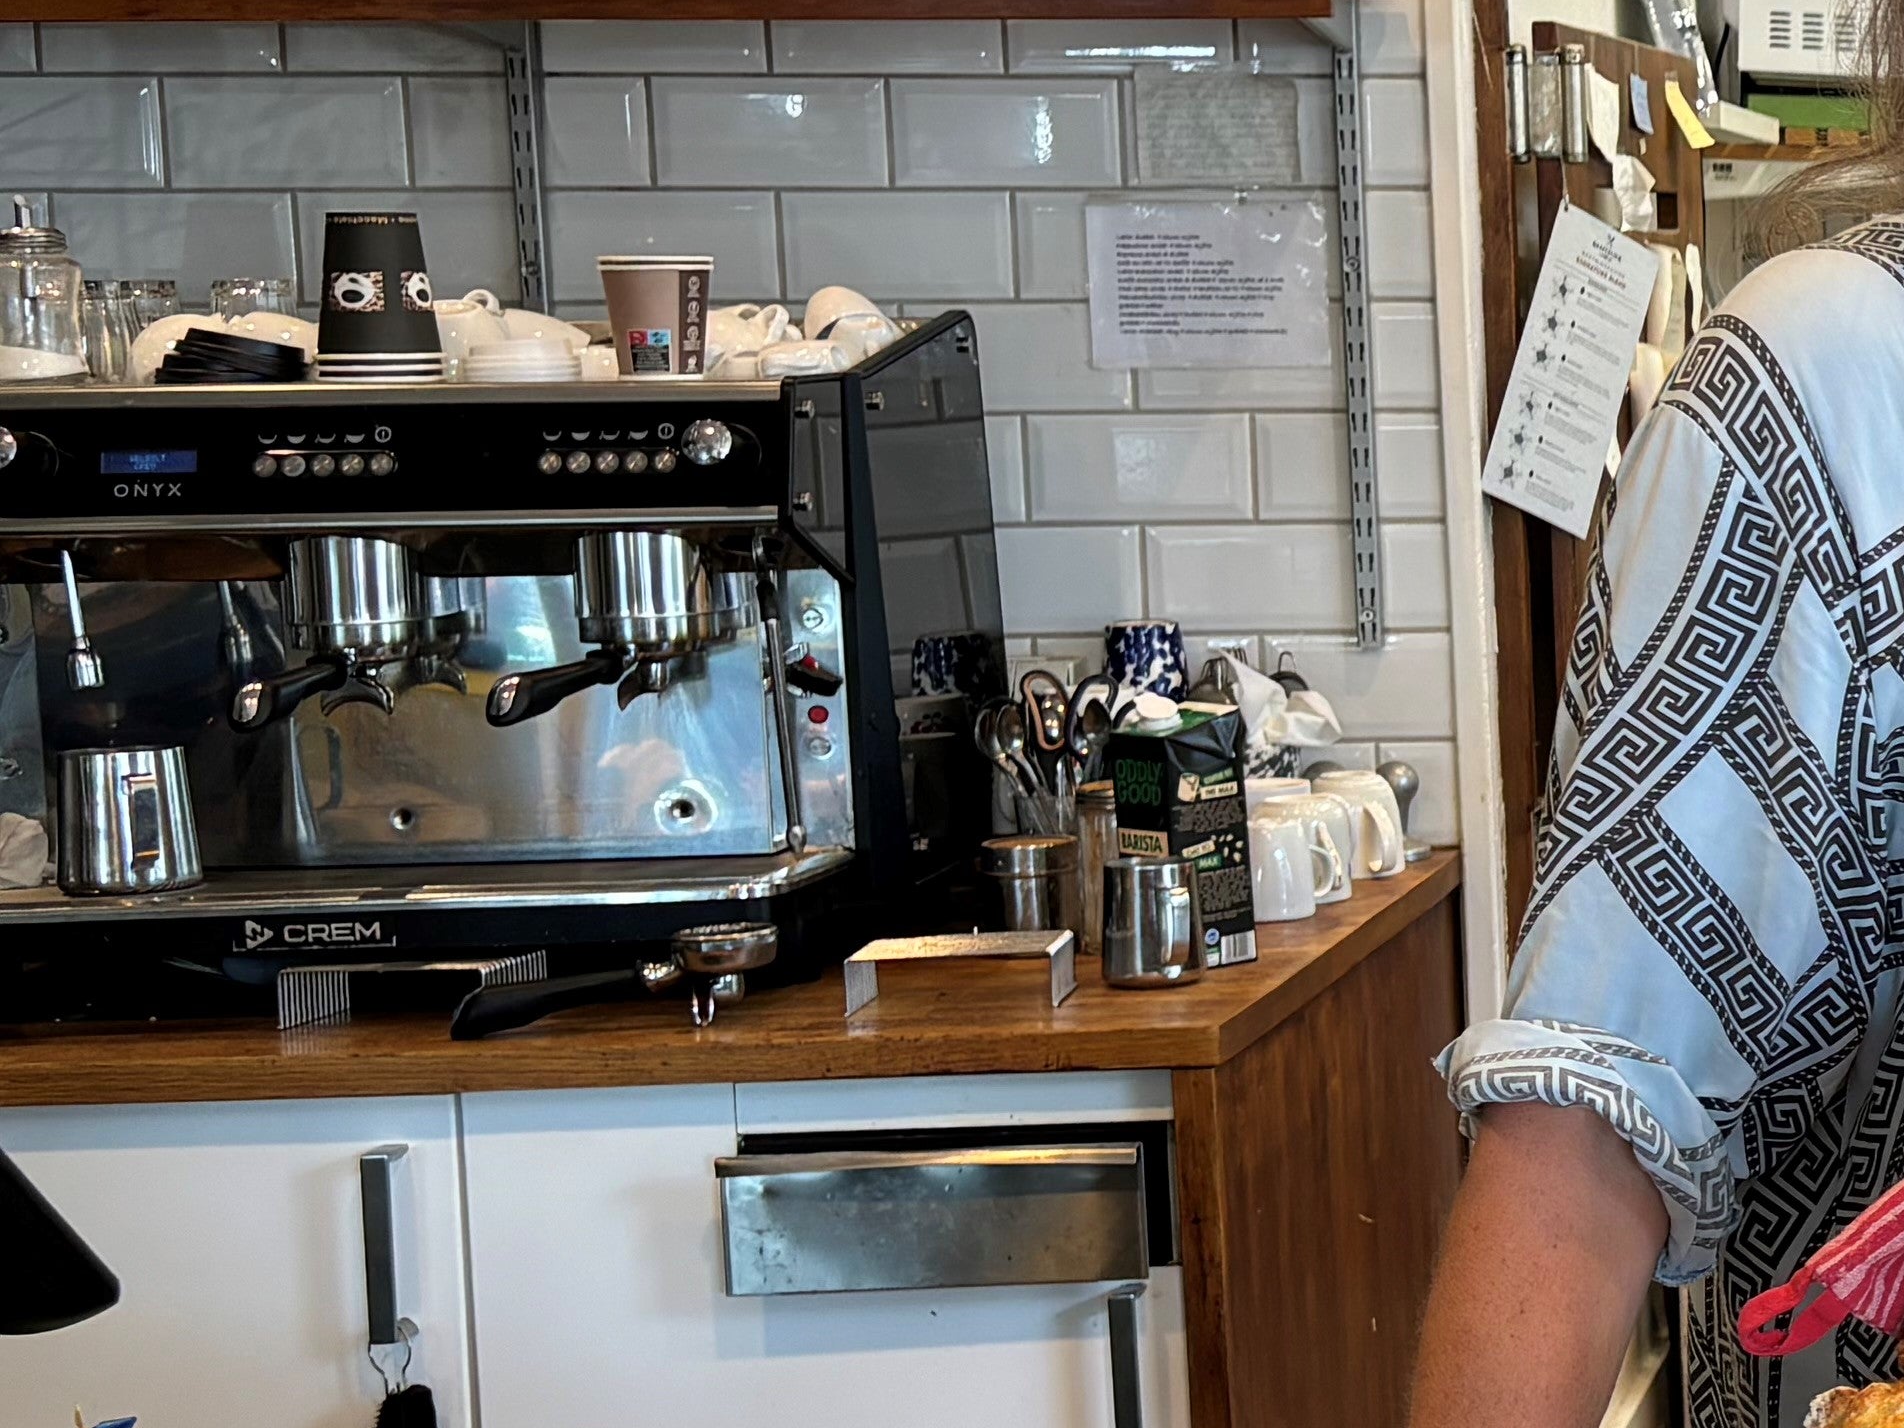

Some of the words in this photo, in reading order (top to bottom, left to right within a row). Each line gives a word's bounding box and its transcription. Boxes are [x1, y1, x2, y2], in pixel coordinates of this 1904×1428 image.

[114, 483, 181, 497] ONYX
[1118, 781, 1161, 806] GOOD
[1121, 833, 1162, 853] BARISTA
[283, 922, 381, 942] CREM
